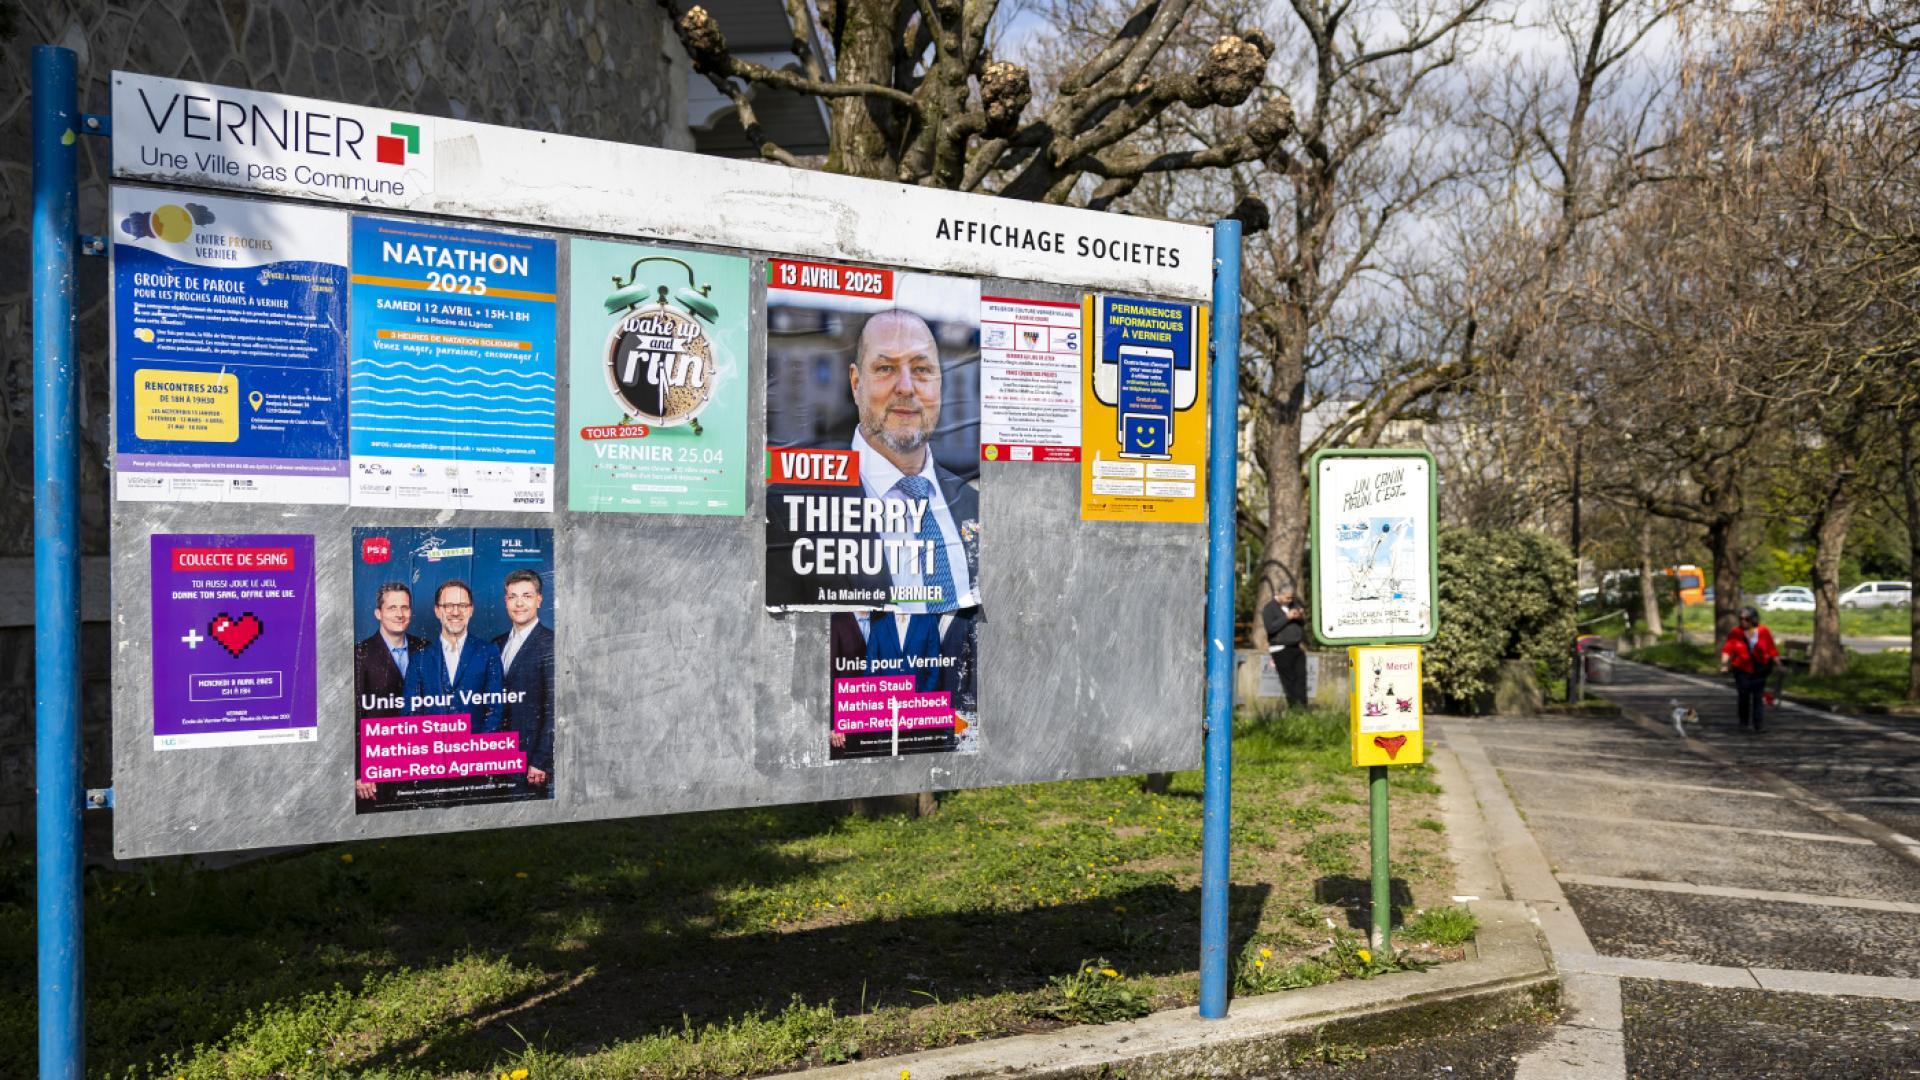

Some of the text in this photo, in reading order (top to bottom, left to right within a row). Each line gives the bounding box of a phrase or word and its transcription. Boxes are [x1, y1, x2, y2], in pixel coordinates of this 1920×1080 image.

[138, 88, 364, 160] VERNIER
[141, 145, 405, 196] Une Ville pas Commune
[196, 233, 273, 251] ENTRE PROCHES
[935, 218, 1181, 269] AFFICHAGE SOCIETES
[196, 247, 237, 261] VERNIER
[383, 241, 528, 277] NATATHON
[134, 273, 181, 289] GROUPE
[185, 276, 200, 290] DE
[203, 277, 246, 294] PAROLE
[426, 272, 487, 296] 2025
[779, 264, 883, 294] 13 AVRIL 2025
[134, 288, 156, 299] POUR
[159, 290, 172, 300] LES
[174, 291, 211, 303] PROCHES
[213, 294, 246, 306] AIDANTS
[257, 297, 289, 309] VERNIER
[376, 298, 530, 322] SAMEDI 12 AVRIL 15H-18H
[1111, 303, 1182, 319] PERMANENCES
[431, 317, 456, 326] Piscine
[469, 321, 494, 329] Lignon
[624, 316, 700, 342] wake up
[1110, 316, 1184, 332] INFORMATIQUES
[397, 332, 429, 342] HEURES
[442, 336, 479, 346] NATATION
[480, 338, 520, 349] SOLIDAIRE
[650, 339, 673, 350] and
[1132, 330, 1172, 342] VERNIER
[373, 340, 399, 350] Venez
[403, 344, 432, 356] nager,
[436, 346, 481, 358] parrainer,
[485, 350, 532, 364] encourager
[622, 350, 704, 388] run
[144, 381, 228, 394] RENCONTRES 2025
[171, 395, 184, 403] 18H
[586, 426, 644, 438] TOUR 2025
[594, 443, 724, 464] VERNIER 25.04
[780, 452, 849, 481] VOTEZ
[1353, 467, 1404, 494] UN CANIN
[783, 495, 929, 533] THIERRY
[367, 546, 380, 554] PS
[502, 539, 522, 547] PLR
[179, 553, 288, 566] COLLECTE DE SANG
[792, 538, 935, 575] CERUTTI
[192, 580, 204, 588] TOI
[205, 580, 227, 588] AUSSI
[229, 579, 249, 587] JOUE
[251, 579, 258, 587] LE
[172, 591, 198, 599] DONNE
[200, 591, 215, 599] TON
[216, 590, 240, 599] SANG,
[241, 590, 264, 598] OFFRE
[265, 590, 280, 598] UNE
[818, 586, 943, 601] À la Mairie de VERNIER
[835, 654, 957, 673] Unis pour Vernier
[1386, 662, 1413, 670] Merci!
[838, 679, 912, 694] Martin Staub
[361, 689, 526, 711] Unis pour Vernier
[838, 700, 884, 712] Mathias
[365, 719, 467, 737] Martin Staub
[899, 715, 953, 729] Agramunt
[366, 737, 515, 758] Mathias Buschbeck
[365, 758, 522, 779] Gian-Reto Agramunt
